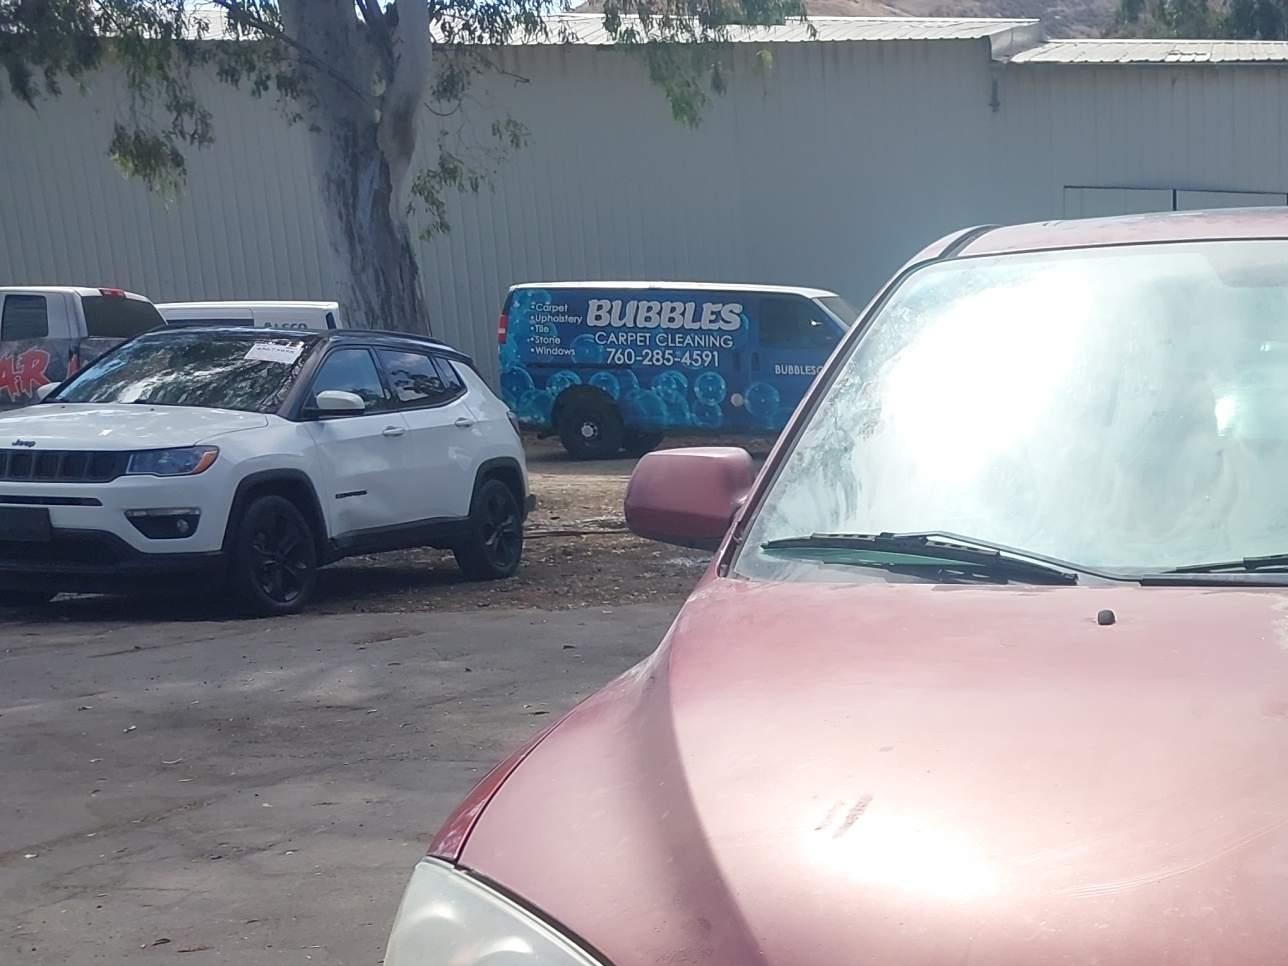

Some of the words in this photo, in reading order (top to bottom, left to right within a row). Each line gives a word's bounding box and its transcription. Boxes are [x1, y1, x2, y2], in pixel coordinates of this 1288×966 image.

[535, 303, 568, 313] Carpet
[535, 314, 583, 325] Upholstery
[586, 299, 743, 331] BUBBLES
[535, 324, 550, 333] Tile
[535, 335, 561, 345] Stone
[595, 331, 651, 346] CARPET
[656, 333, 733, 348] CLEANING
[535, 345, 576, 355] Windows
[606, 348, 719, 367] 760-285-4591
